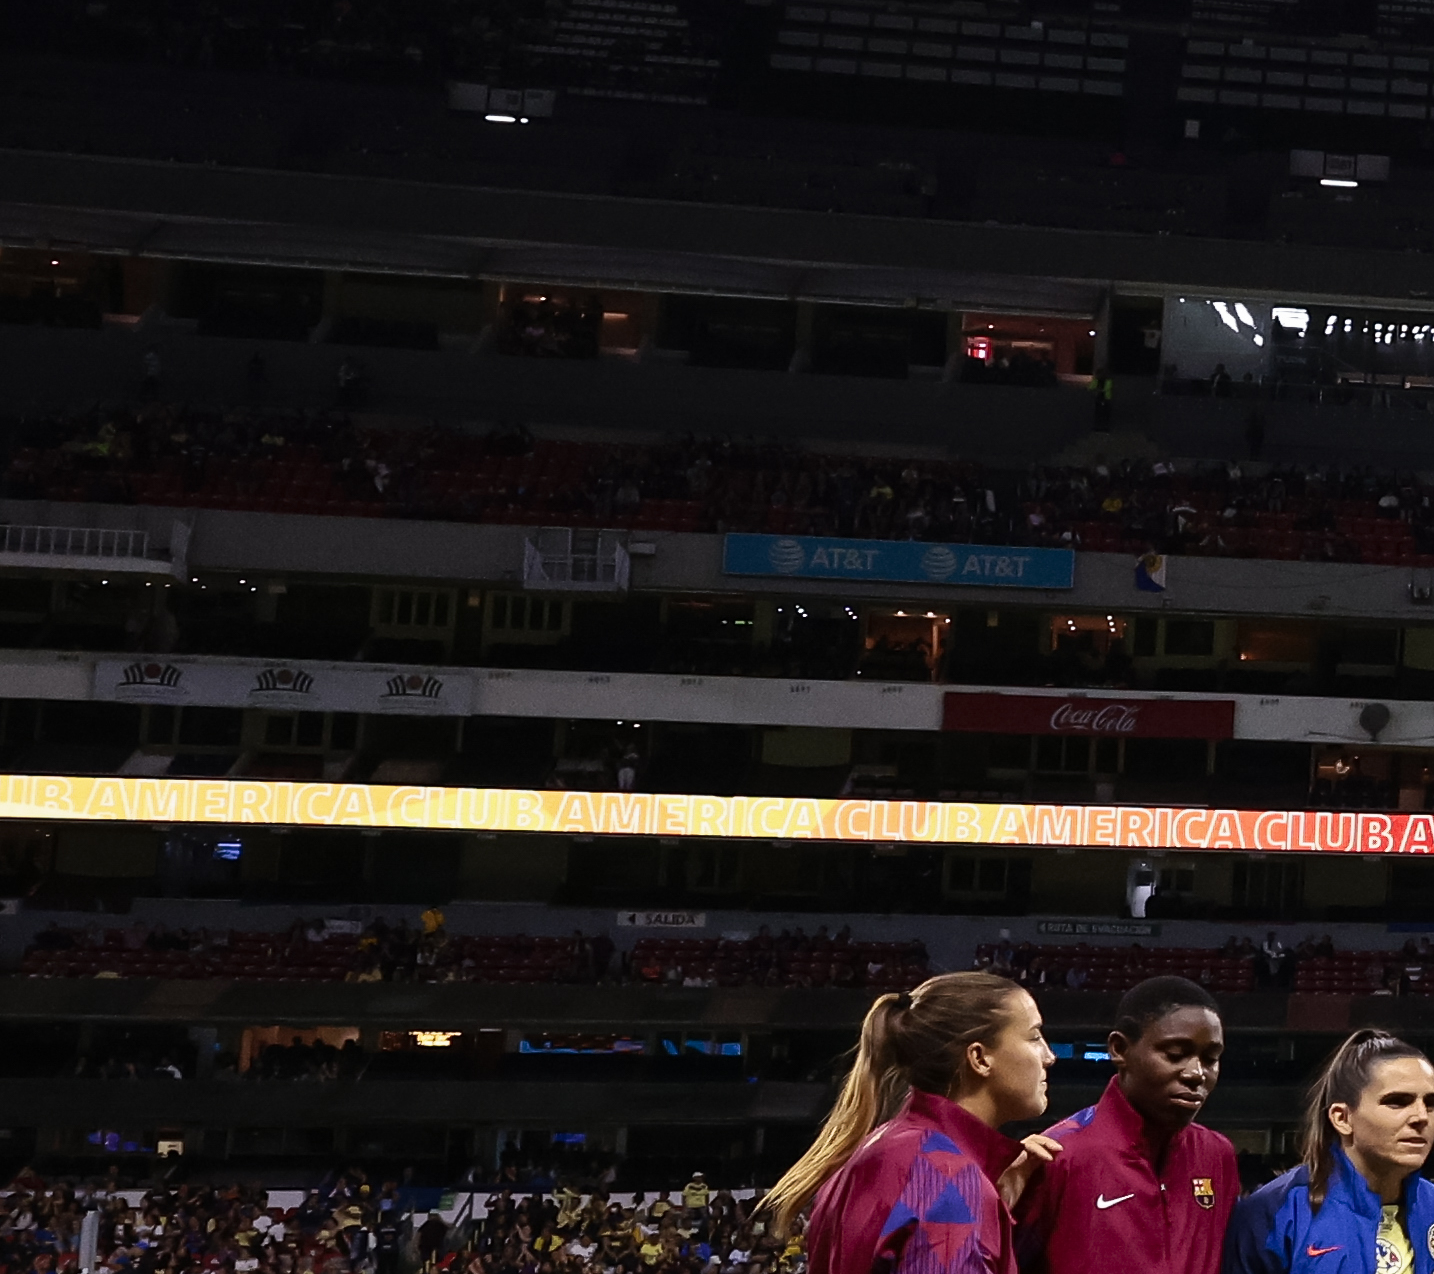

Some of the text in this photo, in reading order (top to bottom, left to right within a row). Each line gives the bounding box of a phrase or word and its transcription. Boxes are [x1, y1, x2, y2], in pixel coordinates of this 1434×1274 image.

[809, 547, 1031, 577] AT&T AT&T
[1050, 702, 1142, 732] Coca-Cola
[84, 778, 376, 825] AMERICA
[386, 786, 546, 831] CLUB
[552, 791, 827, 839] AMERICA
[834, 798, 986, 843] CLUB
[989, 804, 1244, 849] AMERICA
[1254, 811, 1395, 853] CLUB
[645, 911, 695, 925] SALIDA
